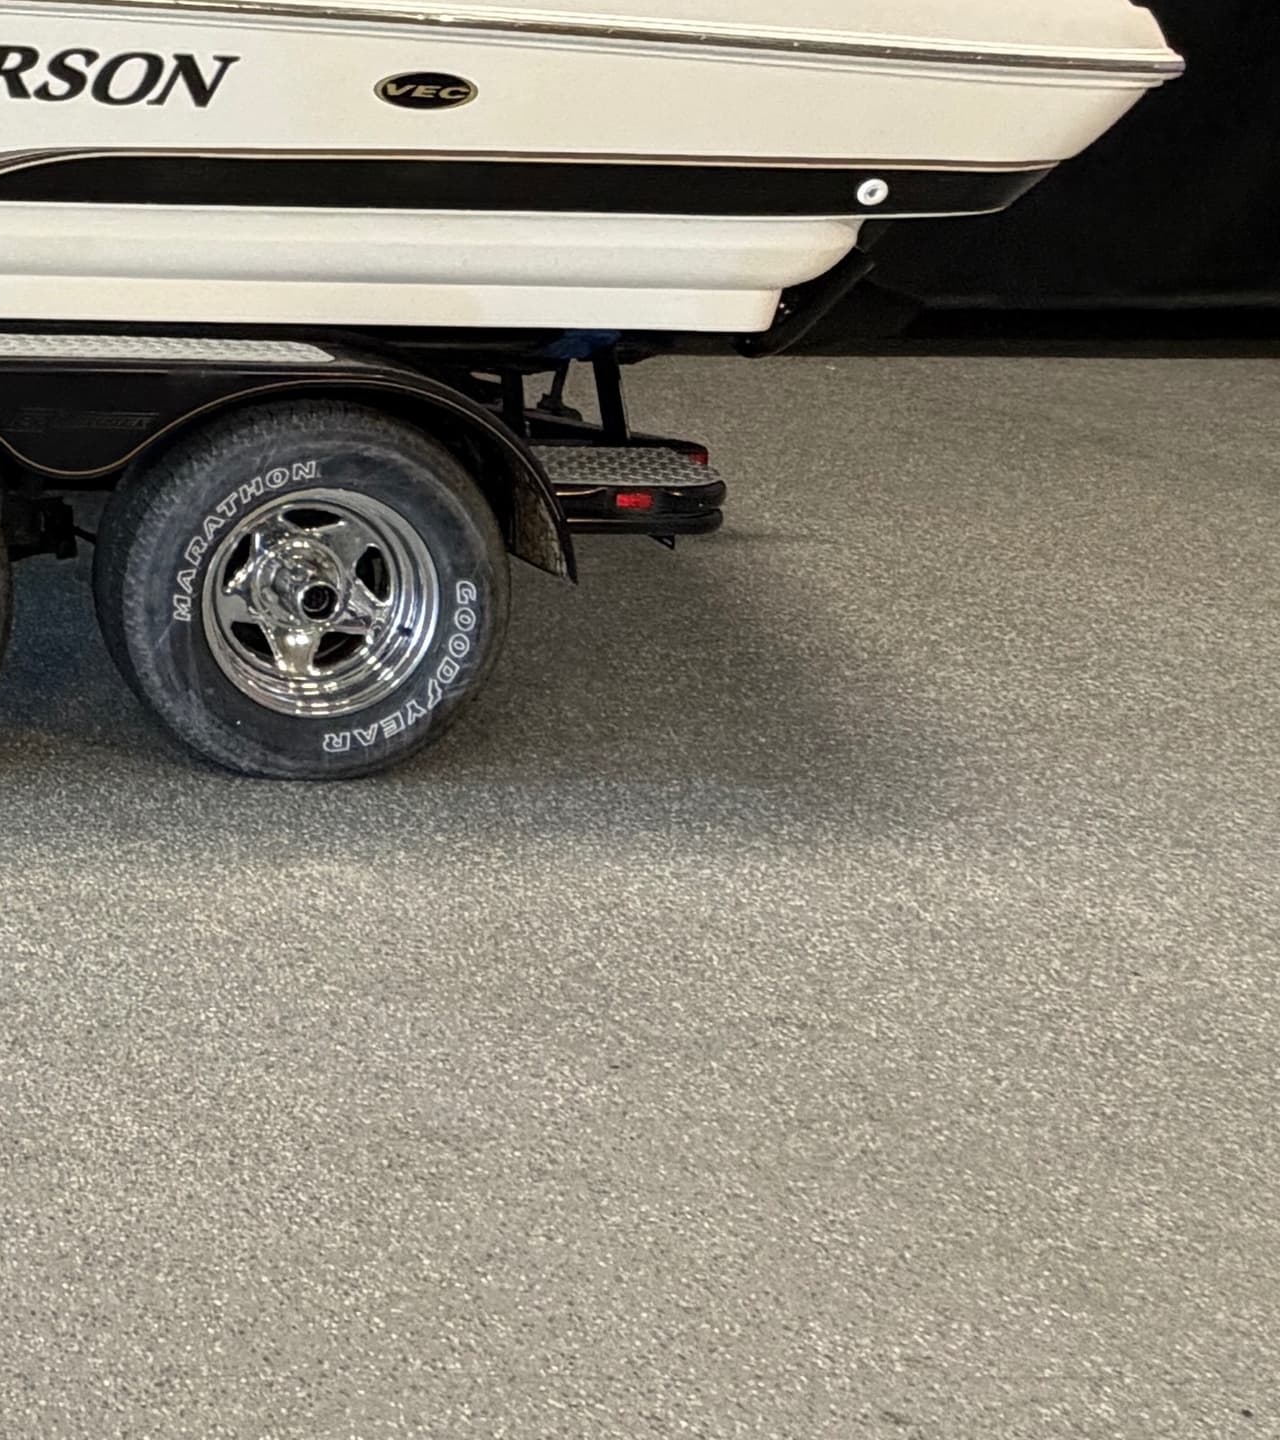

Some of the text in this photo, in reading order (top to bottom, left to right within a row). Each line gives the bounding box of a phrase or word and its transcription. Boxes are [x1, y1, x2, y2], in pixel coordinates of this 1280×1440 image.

[386, 83, 470, 99] VEC
[172, 461, 317, 621] MARATHON
[322, 580, 477, 753] GOODYEAR
